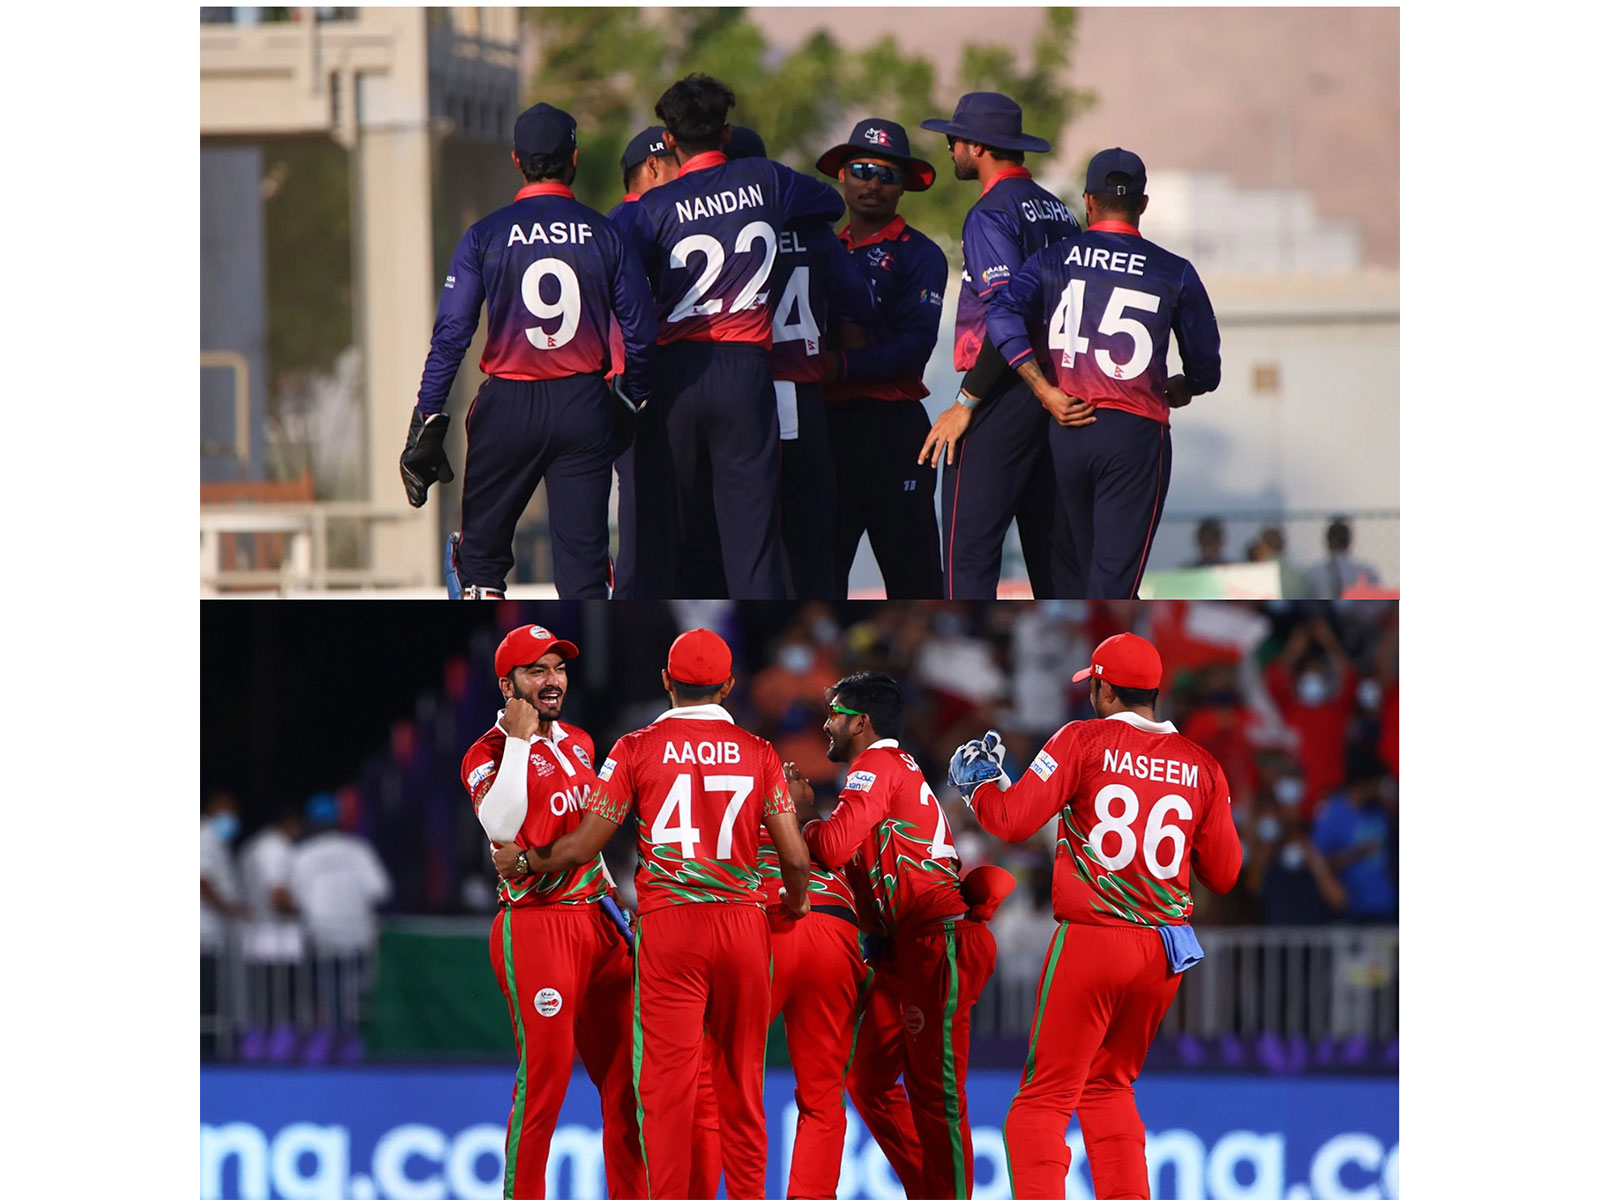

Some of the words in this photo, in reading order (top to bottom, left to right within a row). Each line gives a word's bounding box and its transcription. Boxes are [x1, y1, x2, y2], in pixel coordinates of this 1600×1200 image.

[650, 142, 665, 152] LR
[675, 183, 765, 224] NANDAN
[507, 221, 593, 248] AASIF
[778, 231, 808, 254] EL
[666, 220, 778, 323] 22
[1063, 245, 1148, 276] AIREE
[521, 257, 582, 350] 9
[1048, 278, 1161, 381] 45
[662, 740, 741, 766] AAQIB
[1102, 748, 1199, 788] NASEEM
[650, 773, 755, 860] 47
[920, 780, 959, 860] 2
[1088, 783, 1193, 880] 86
